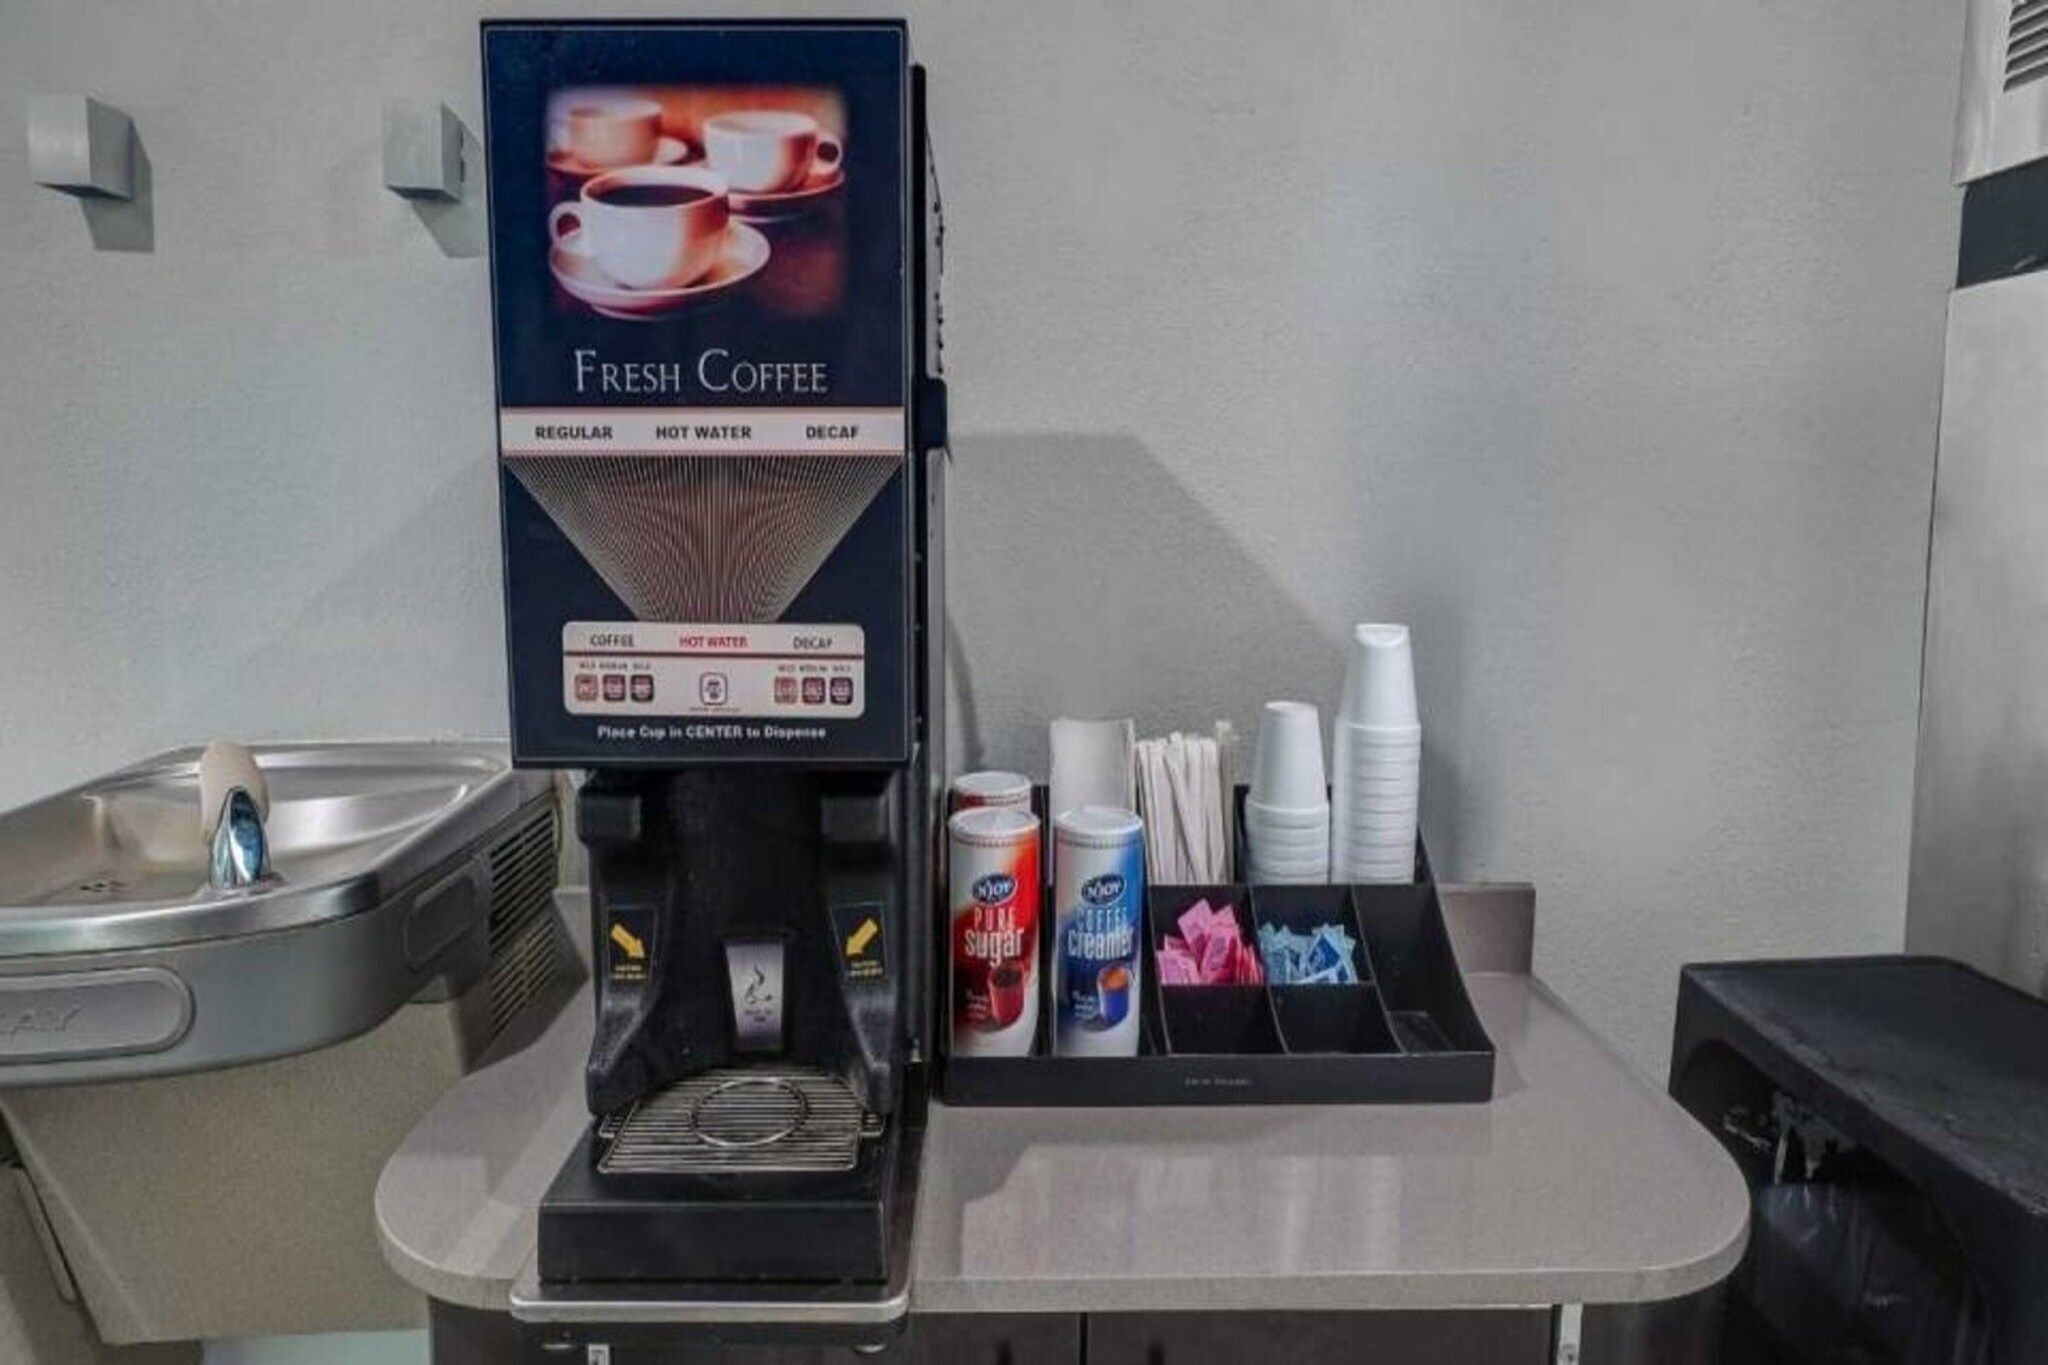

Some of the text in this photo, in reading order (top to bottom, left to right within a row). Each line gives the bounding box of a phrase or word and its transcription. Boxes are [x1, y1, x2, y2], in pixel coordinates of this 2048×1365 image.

[535, 425, 613, 440] REGULAR
[656, 426, 752, 440] HOT WATER
[805, 426, 859, 440] DECAF
[590, 634, 635, 648] COFFEE
[679, 636, 749, 649] HOT WATER
[793, 637, 833, 649] DECAF
[598, 725, 827, 740] Place Cup in CENTER to Dispense
[974, 906, 1015, 931] PURE
